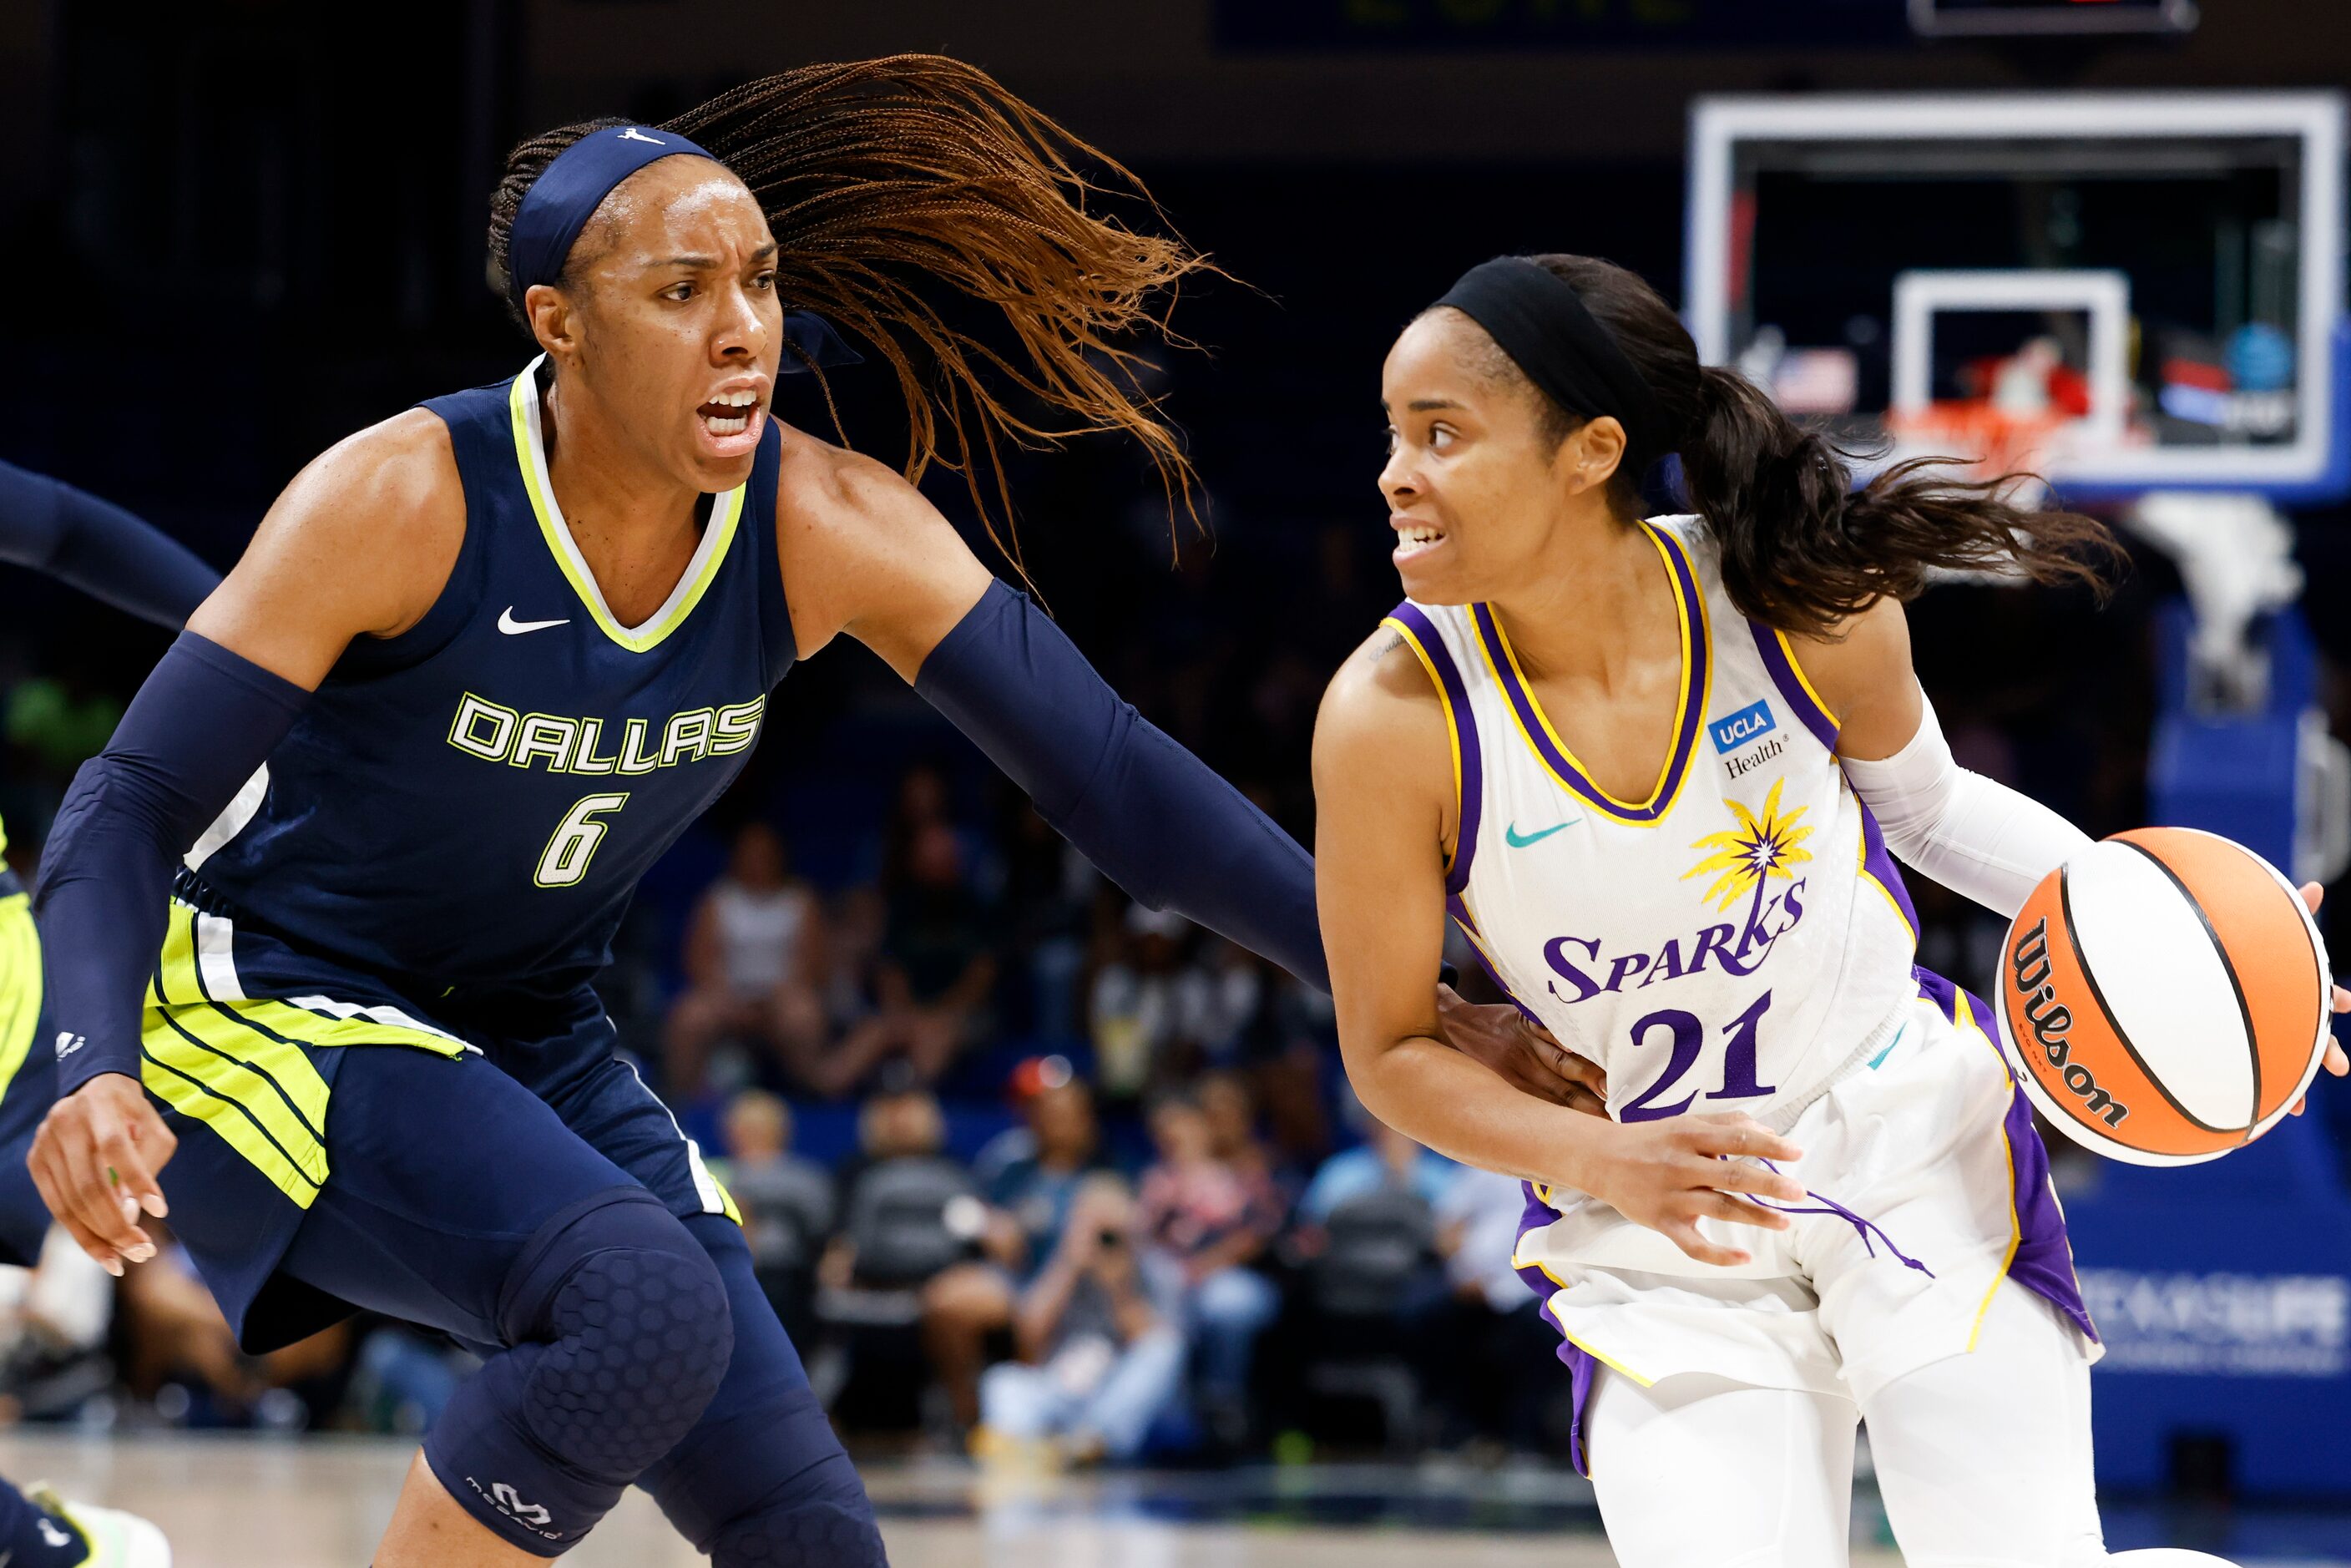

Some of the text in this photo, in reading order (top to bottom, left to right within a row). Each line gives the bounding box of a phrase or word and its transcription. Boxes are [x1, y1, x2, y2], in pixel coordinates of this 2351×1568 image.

[446, 691, 766, 776] DALLAS
[1720, 711, 1767, 745] UCLA
[533, 792, 630, 888] 6
[1543, 873, 1807, 1004] SPARKS
[1620, 988, 1776, 1124] 21
[2013, 915, 2131, 1130] Wilson
